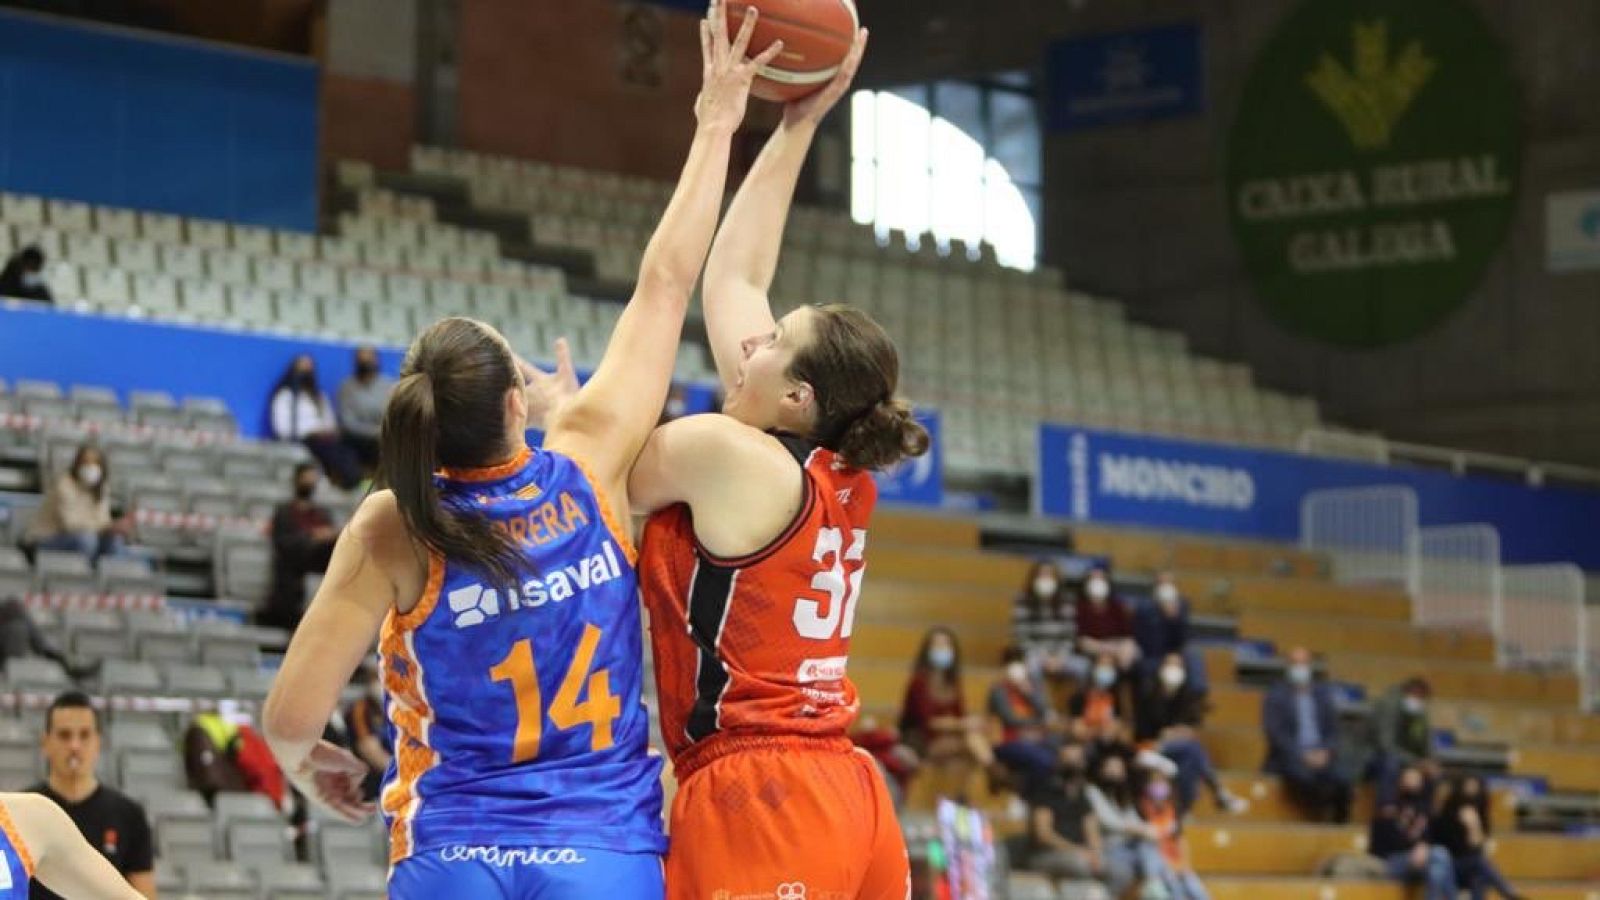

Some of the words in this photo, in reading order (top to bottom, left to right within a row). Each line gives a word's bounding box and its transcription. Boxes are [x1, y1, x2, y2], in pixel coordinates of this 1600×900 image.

[1239, 172, 1366, 219] CAIXA
[1372, 155, 1510, 204] RURAL
[1099, 453, 1254, 508] MONCHO
[489, 622, 621, 764] 14
